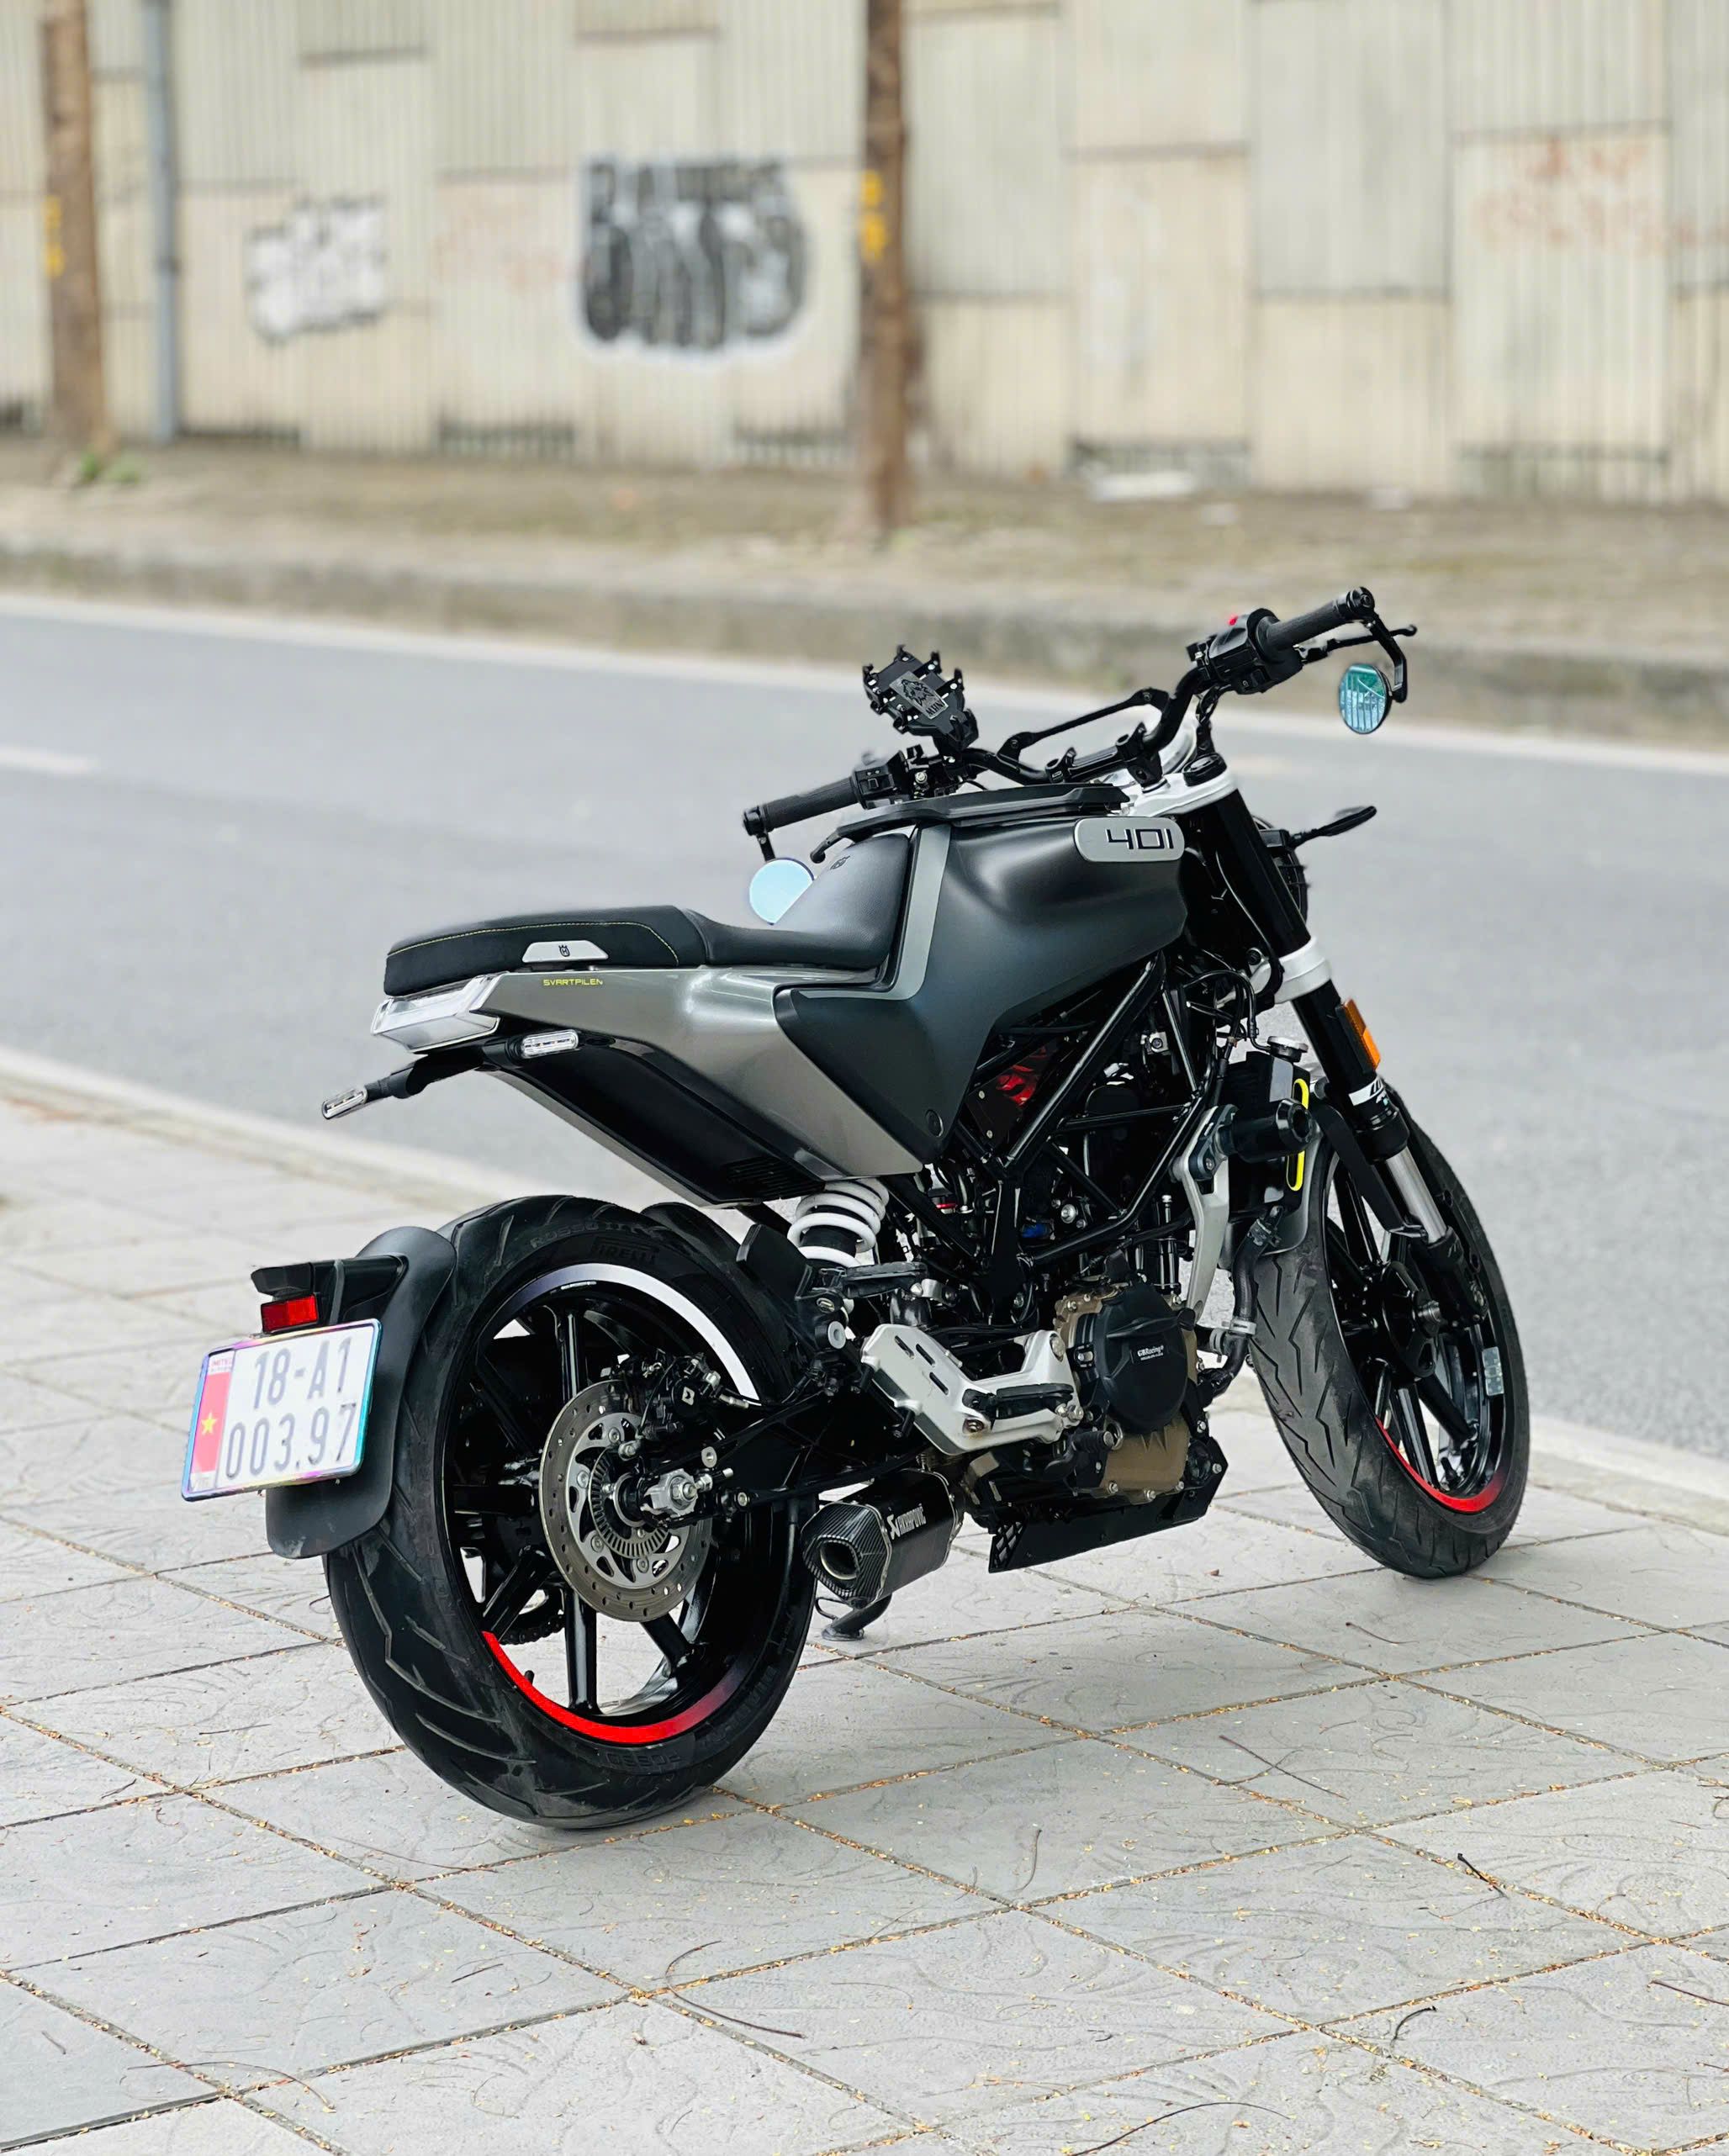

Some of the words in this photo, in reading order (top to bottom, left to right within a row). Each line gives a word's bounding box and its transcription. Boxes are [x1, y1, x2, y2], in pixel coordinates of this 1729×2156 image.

[1106, 828, 1174, 850] 401
[542, 978, 604, 987] SVARTPILEN
[254, 1336, 352, 1409] 18-A1
[225, 1402, 357, 1480] 003.97
